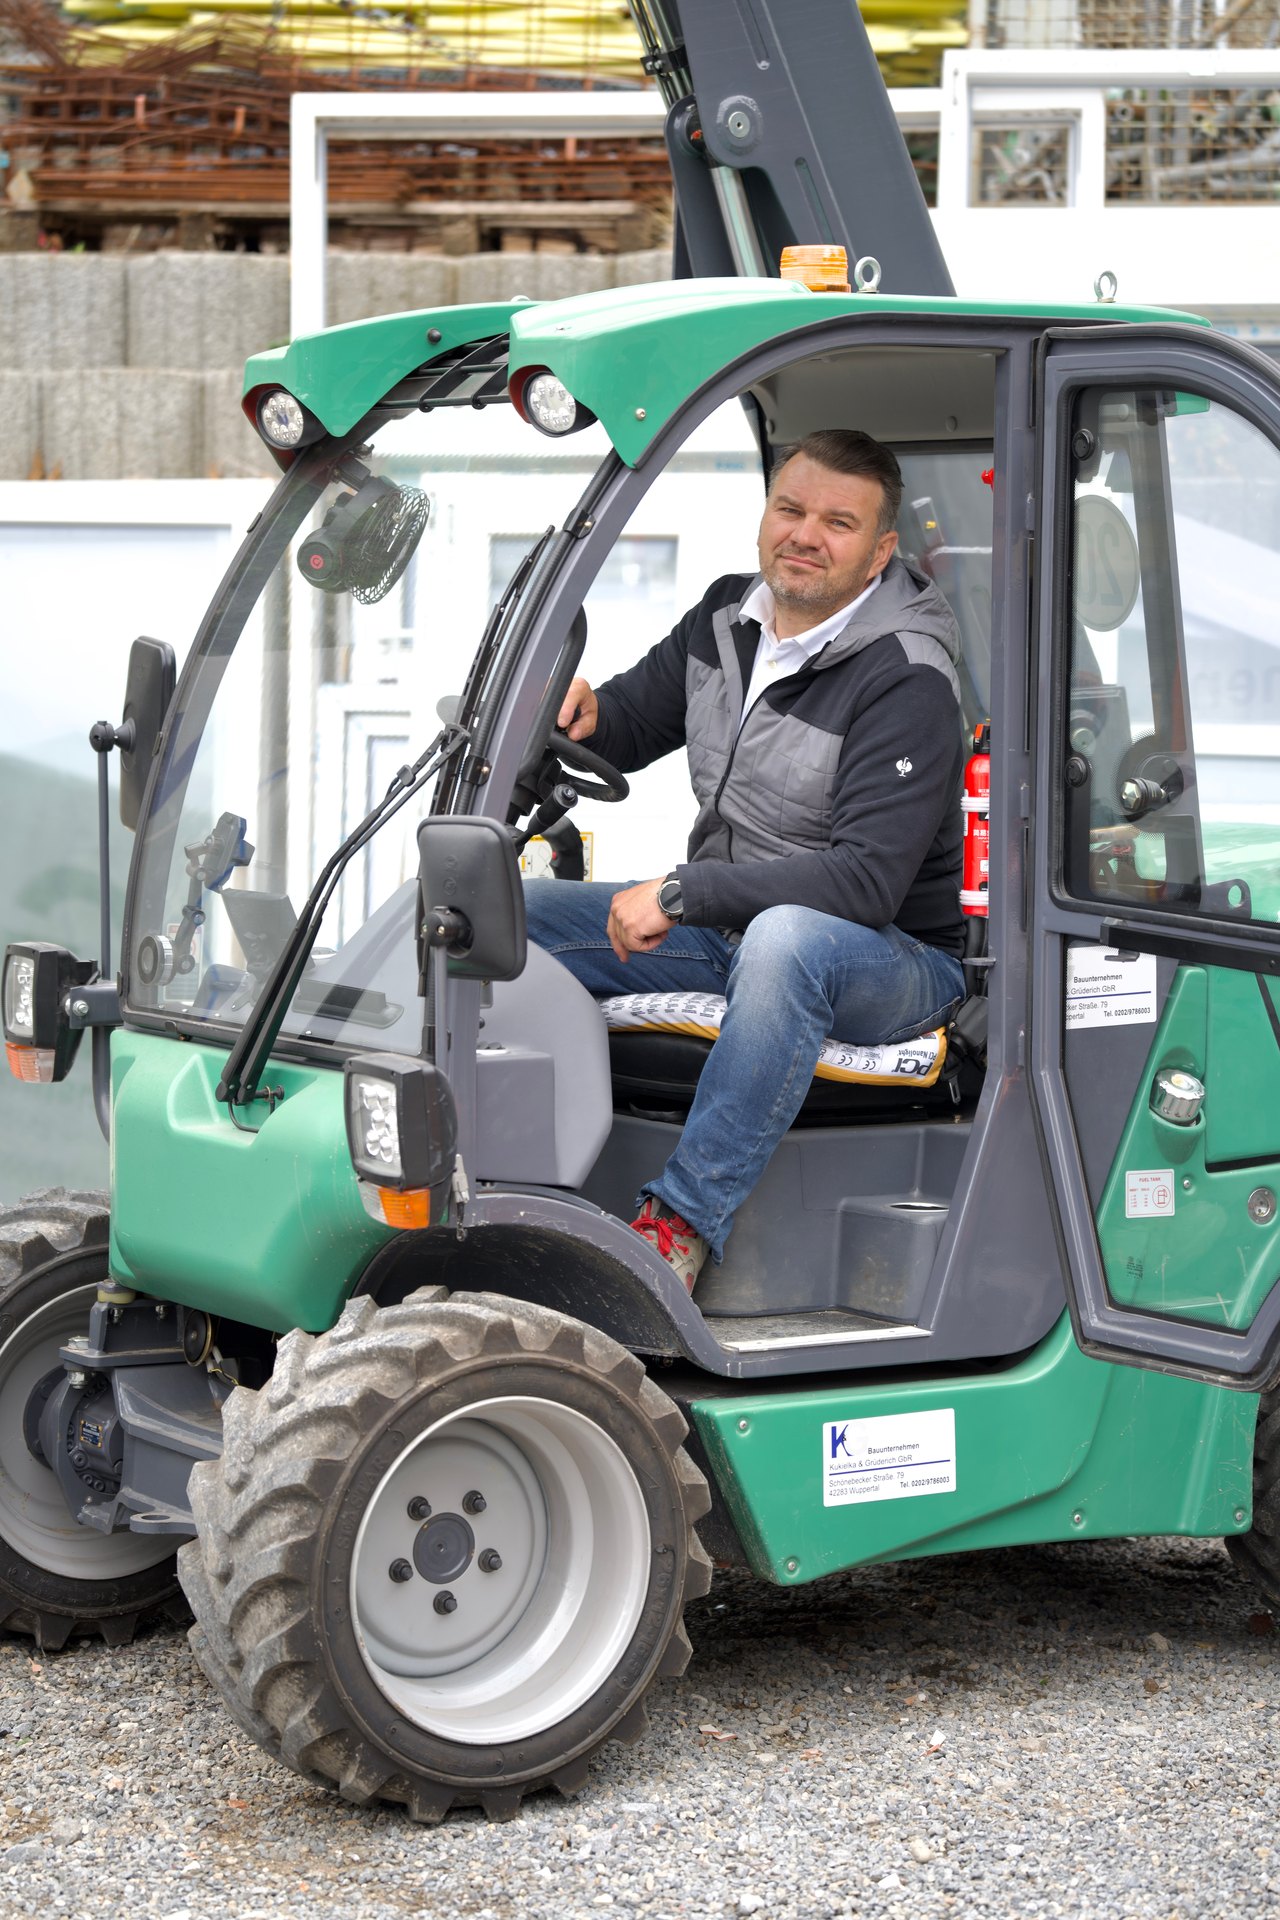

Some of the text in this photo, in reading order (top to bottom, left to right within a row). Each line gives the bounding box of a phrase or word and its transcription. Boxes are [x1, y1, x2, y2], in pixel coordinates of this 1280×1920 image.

[1073, 974, 1123, 983] Bauunternehmen
[1070, 986, 1100, 995] Grüderich
[1101, 984, 1116, 993] GbR
[1100, 1000, 1108, 1008] 79
[1104, 1007, 1151, 1018] Tel. 0202/9786003
[894, 1057, 933, 1076] PCI
[867, 1443, 920, 1455] Bauunternehmen
[829, 1454, 913, 1471] Kukielka & Grüderich GbR
[829, 1476, 872, 1487] Schönebecker
[896, 1471, 905, 1479] 79
[911, 1476, 950, 1487] 0202/9786003
[829, 1484, 880, 1496] 42283 Wuppertal
